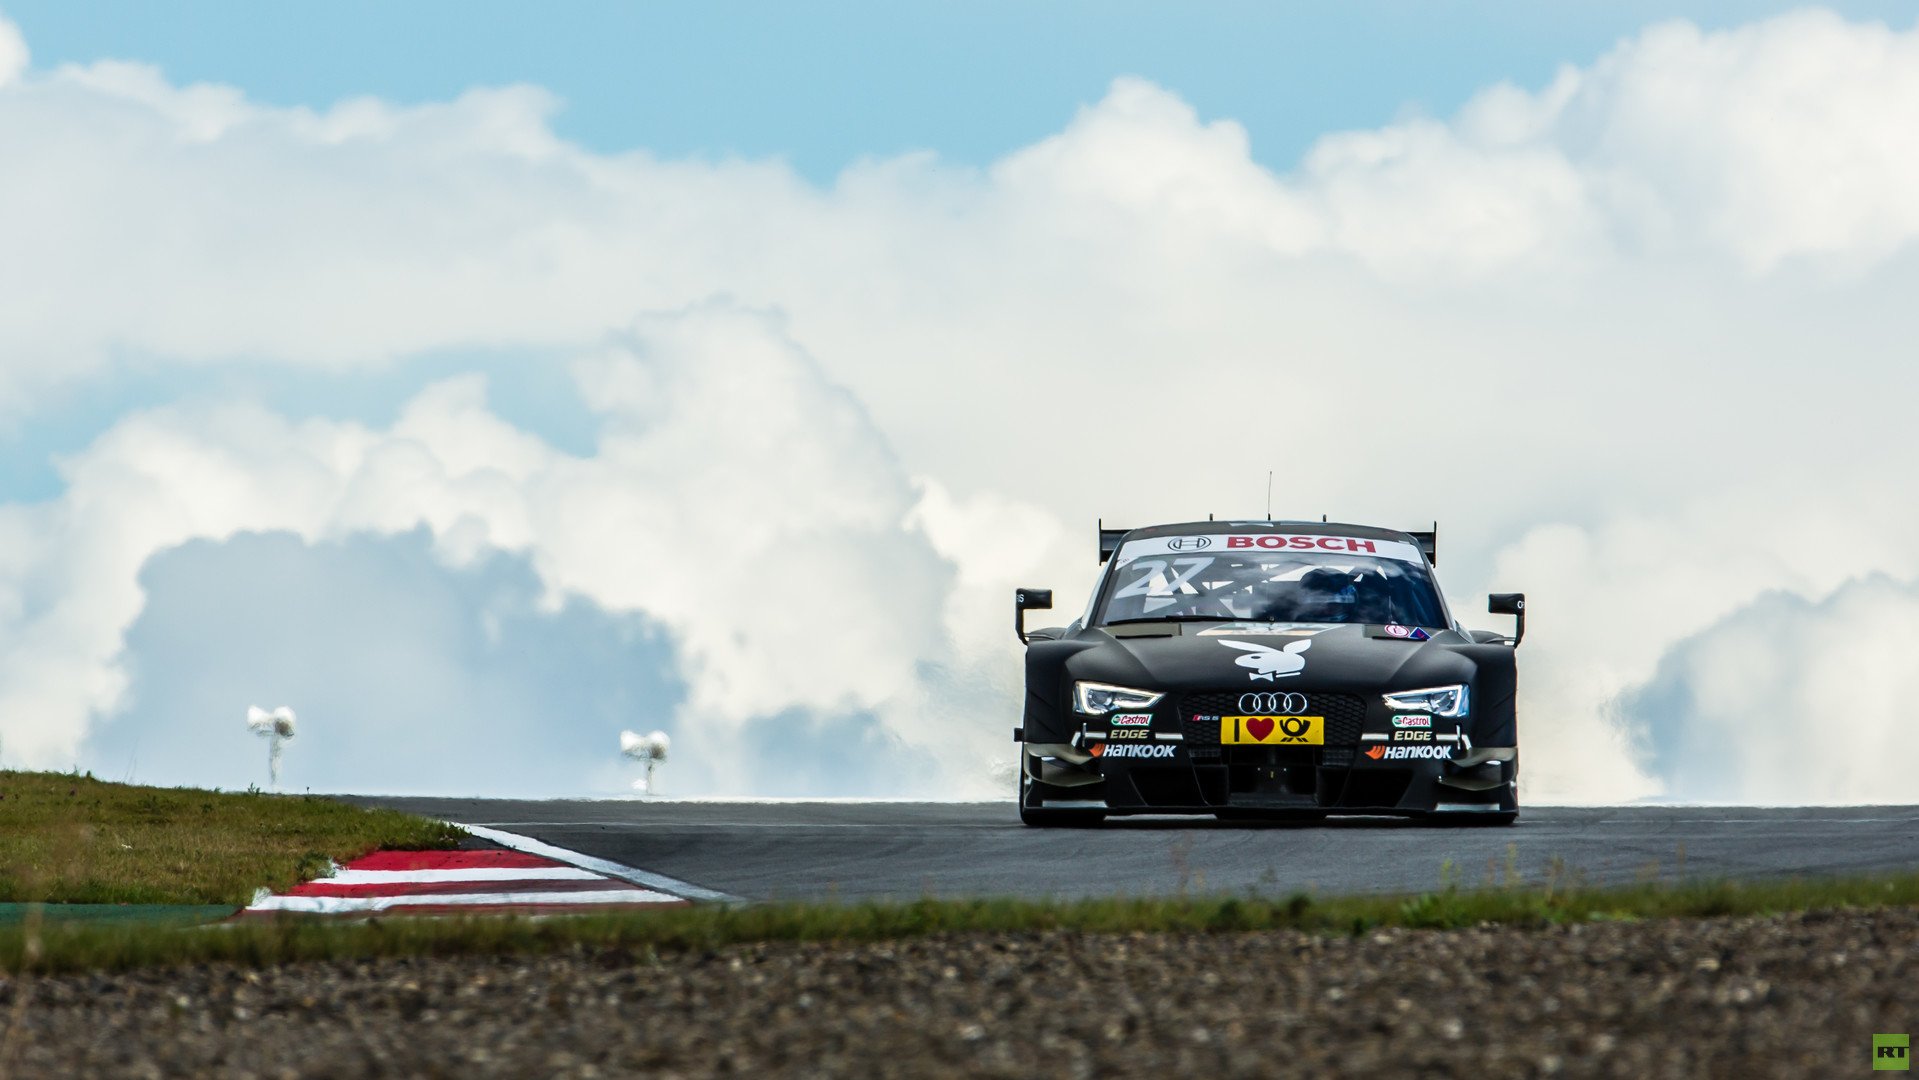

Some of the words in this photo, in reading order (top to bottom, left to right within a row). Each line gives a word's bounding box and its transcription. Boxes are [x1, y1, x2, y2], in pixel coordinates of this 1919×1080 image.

[1227, 536, 1376, 553] BOSCH
[1114, 557, 1215, 599] 27
[1120, 714, 1150, 725] Castrol
[1402, 716, 1430, 726] Castrol
[1110, 729, 1150, 739] EDGE
[1394, 730, 1433, 741] EDGE
